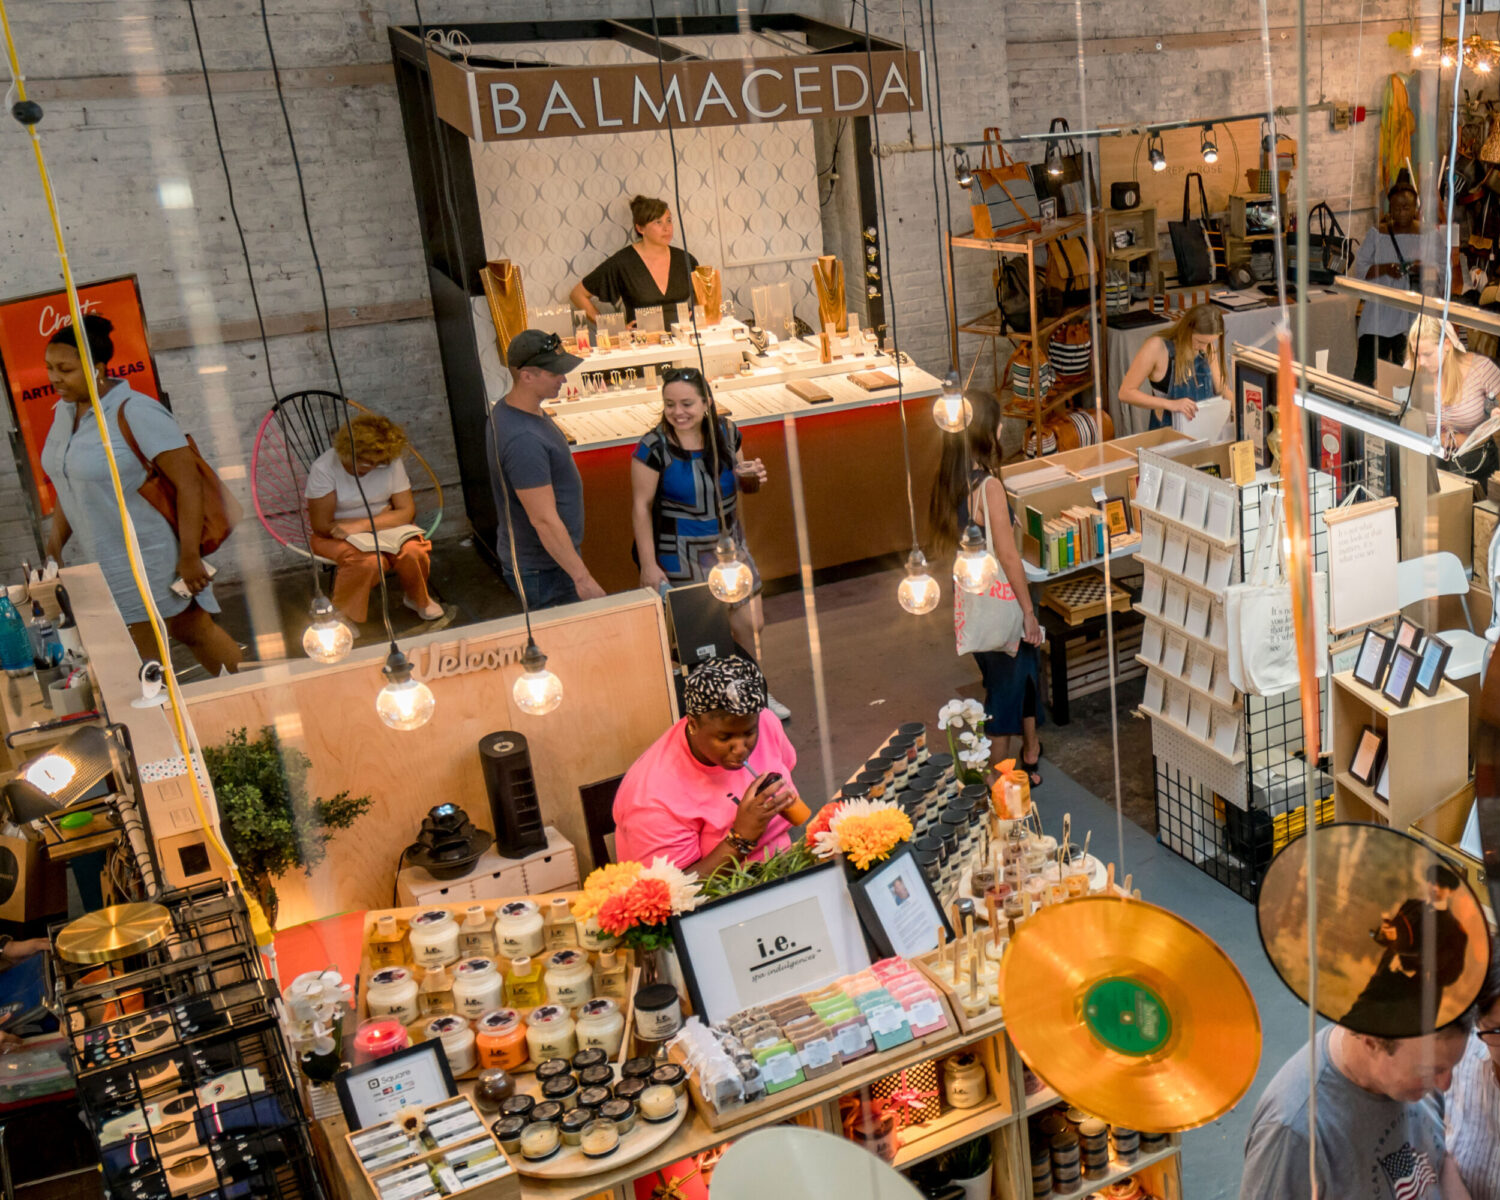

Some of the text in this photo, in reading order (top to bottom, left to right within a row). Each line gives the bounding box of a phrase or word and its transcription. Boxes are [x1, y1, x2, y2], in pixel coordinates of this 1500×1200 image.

[490, 61, 915, 135] BALMACEDA
[39, 300, 103, 337] Cret
[409, 638, 527, 683] Welcom
[757, 936, 796, 958] i.e.
[380, 1069, 412, 1084] Square
